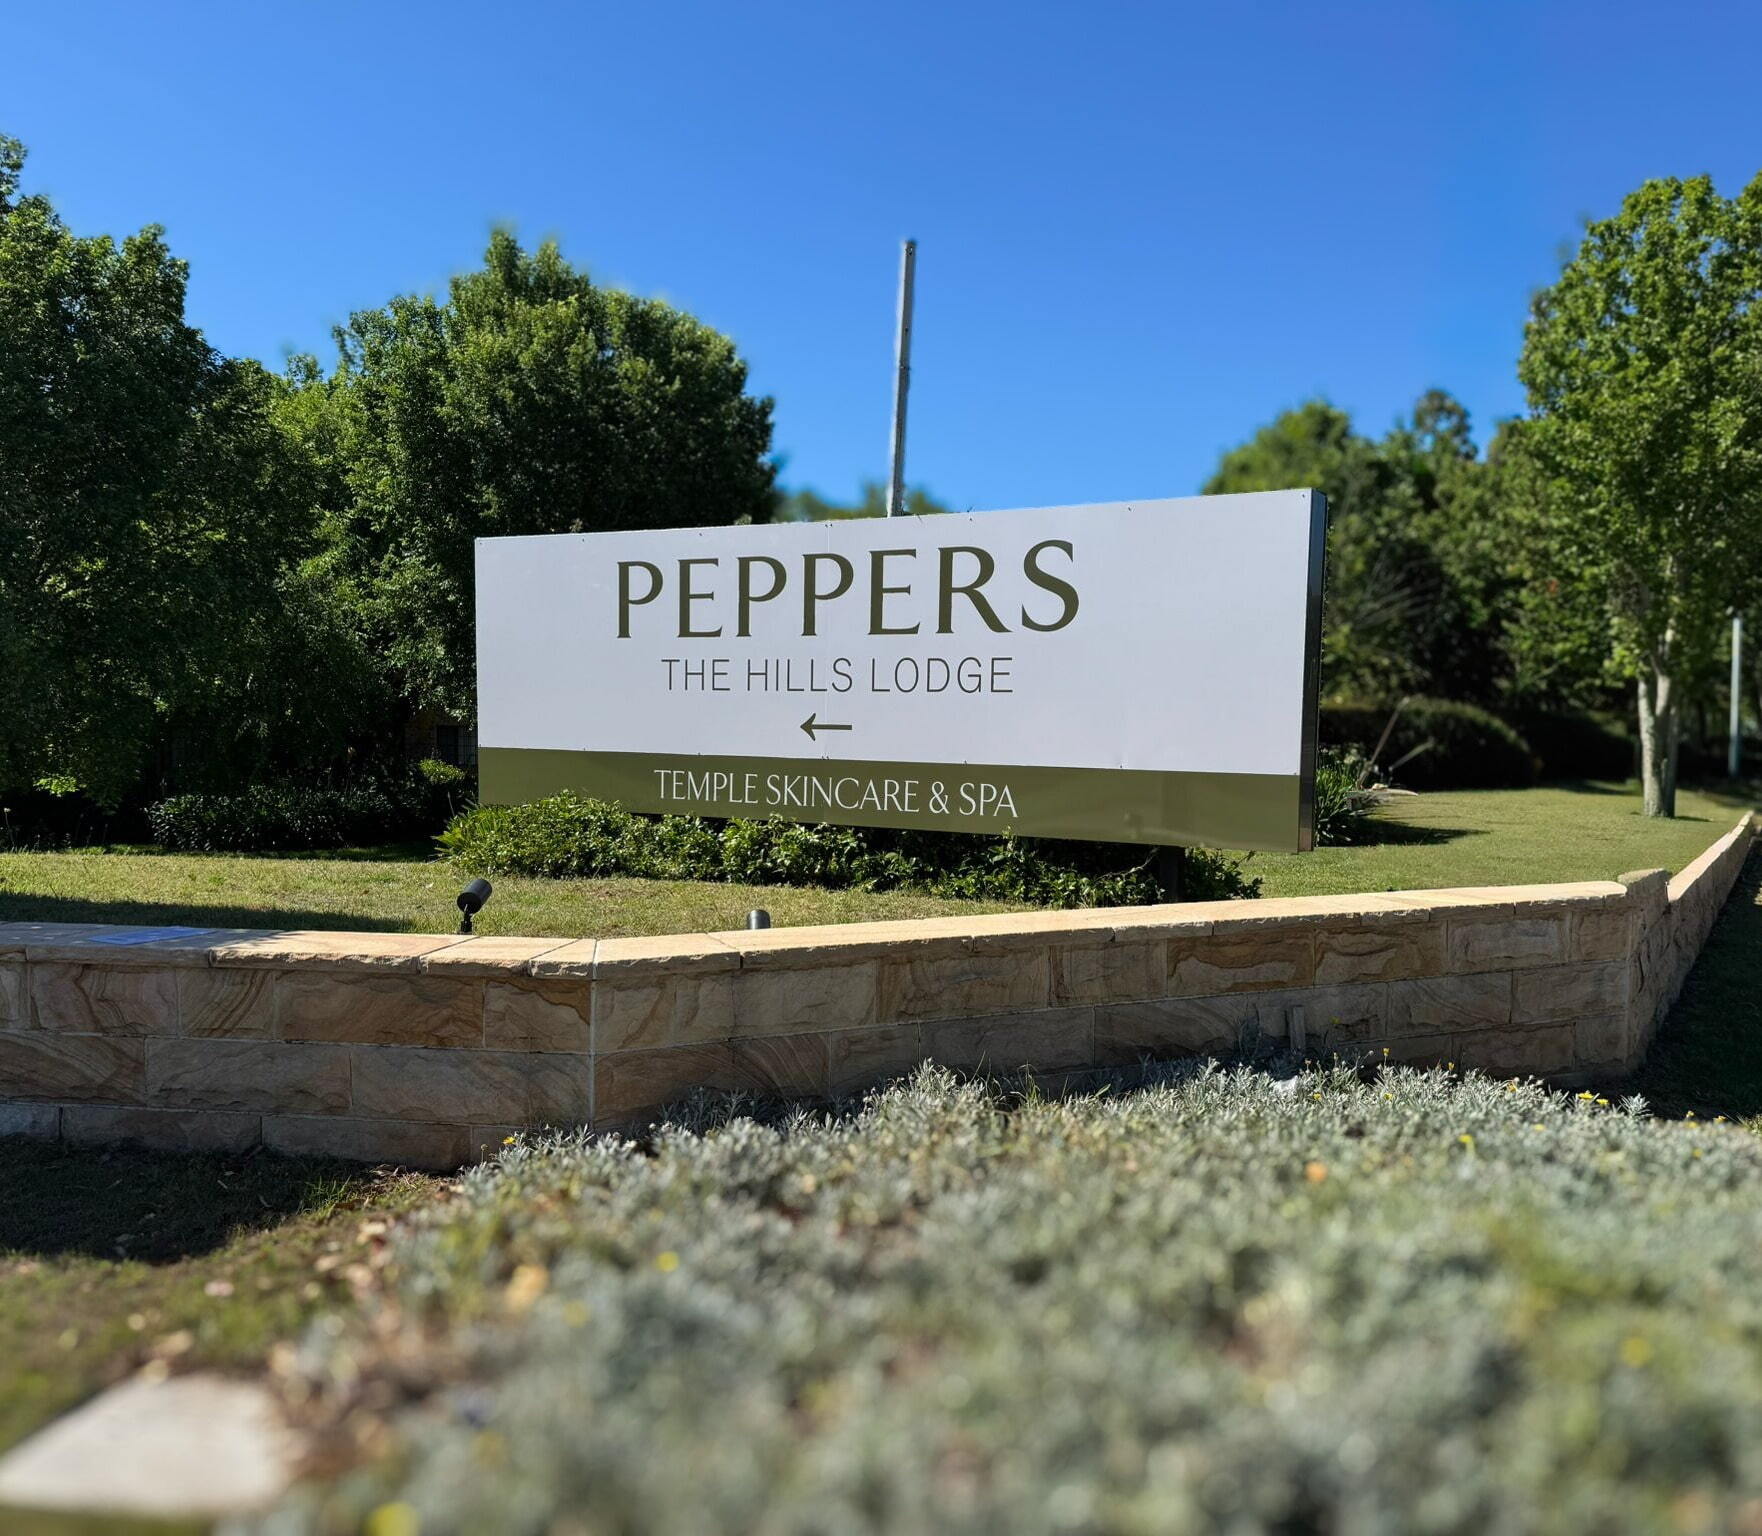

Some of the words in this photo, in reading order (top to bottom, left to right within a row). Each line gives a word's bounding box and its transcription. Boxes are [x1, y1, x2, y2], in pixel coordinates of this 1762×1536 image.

[616, 539, 1080, 639] PEPPERS
[660, 658, 732, 692] THE
[746, 657, 854, 693] HILLS
[871, 656, 1015, 694] LODGE
[653, 769, 759, 804] TEMPLE
[766, 773, 921, 813] SKINCARE
[928, 780, 951, 815] &
[959, 782, 1020, 818] SPA
